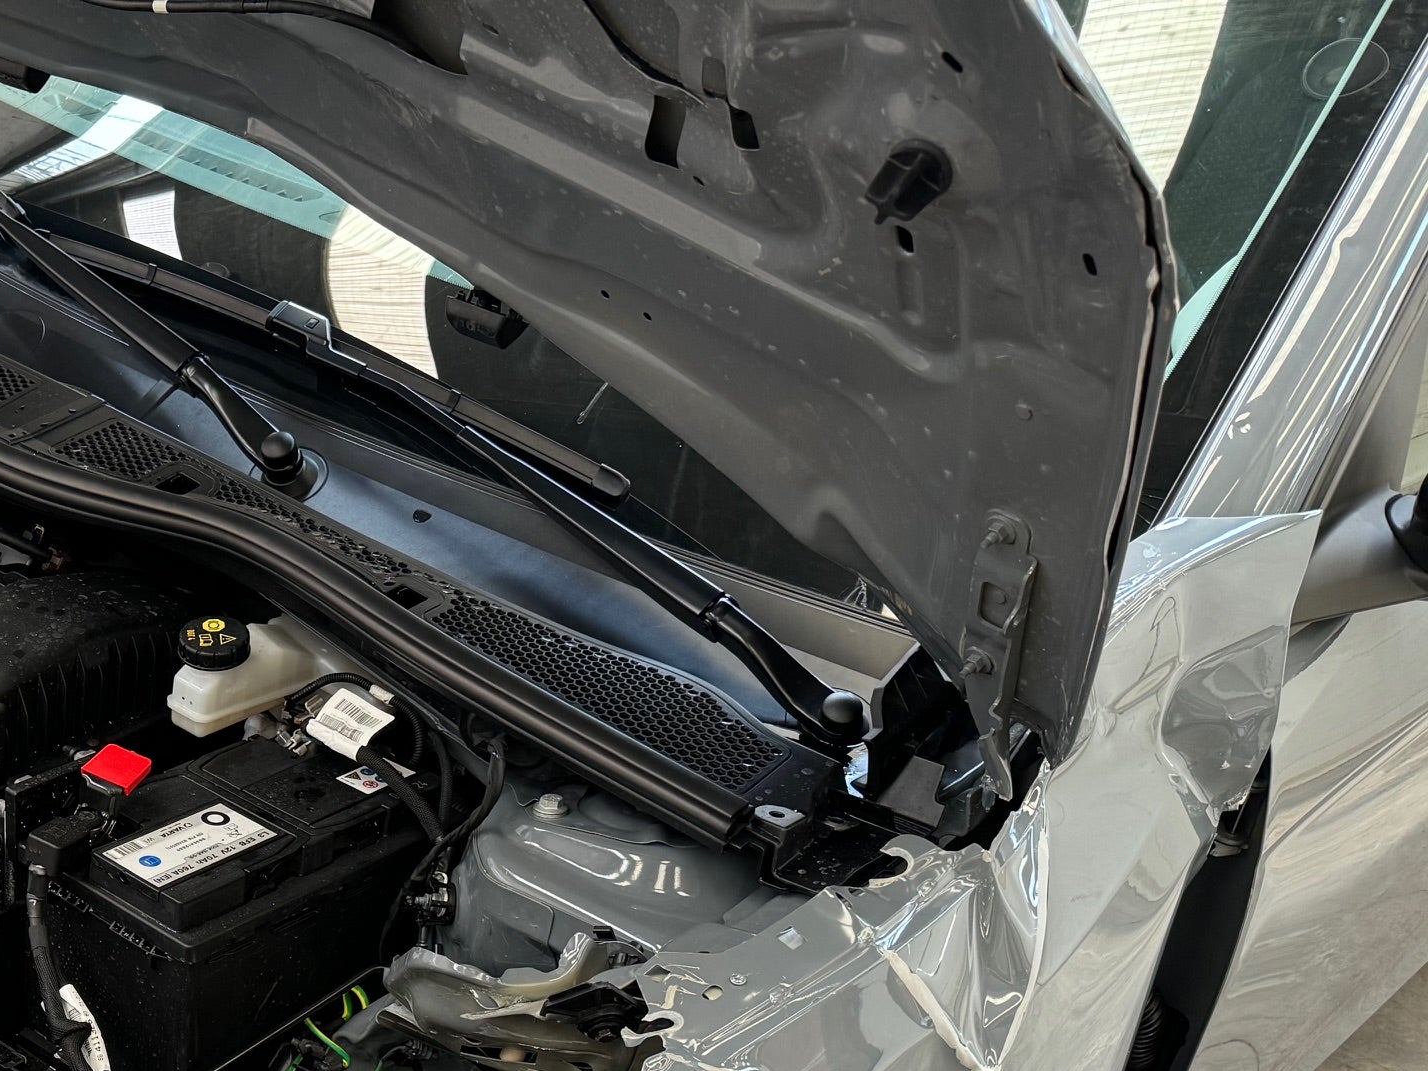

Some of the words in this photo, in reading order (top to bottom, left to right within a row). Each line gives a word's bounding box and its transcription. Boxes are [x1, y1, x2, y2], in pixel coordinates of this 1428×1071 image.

[159, 826, 184, 837] VARTA
[237, 837, 256, 846] EFB
[219, 845, 237, 854] 12V
[194, 853, 219, 865] 70Ah
[170, 864, 195, 875] 760A
[151, 873, 173, 883] (EN)
